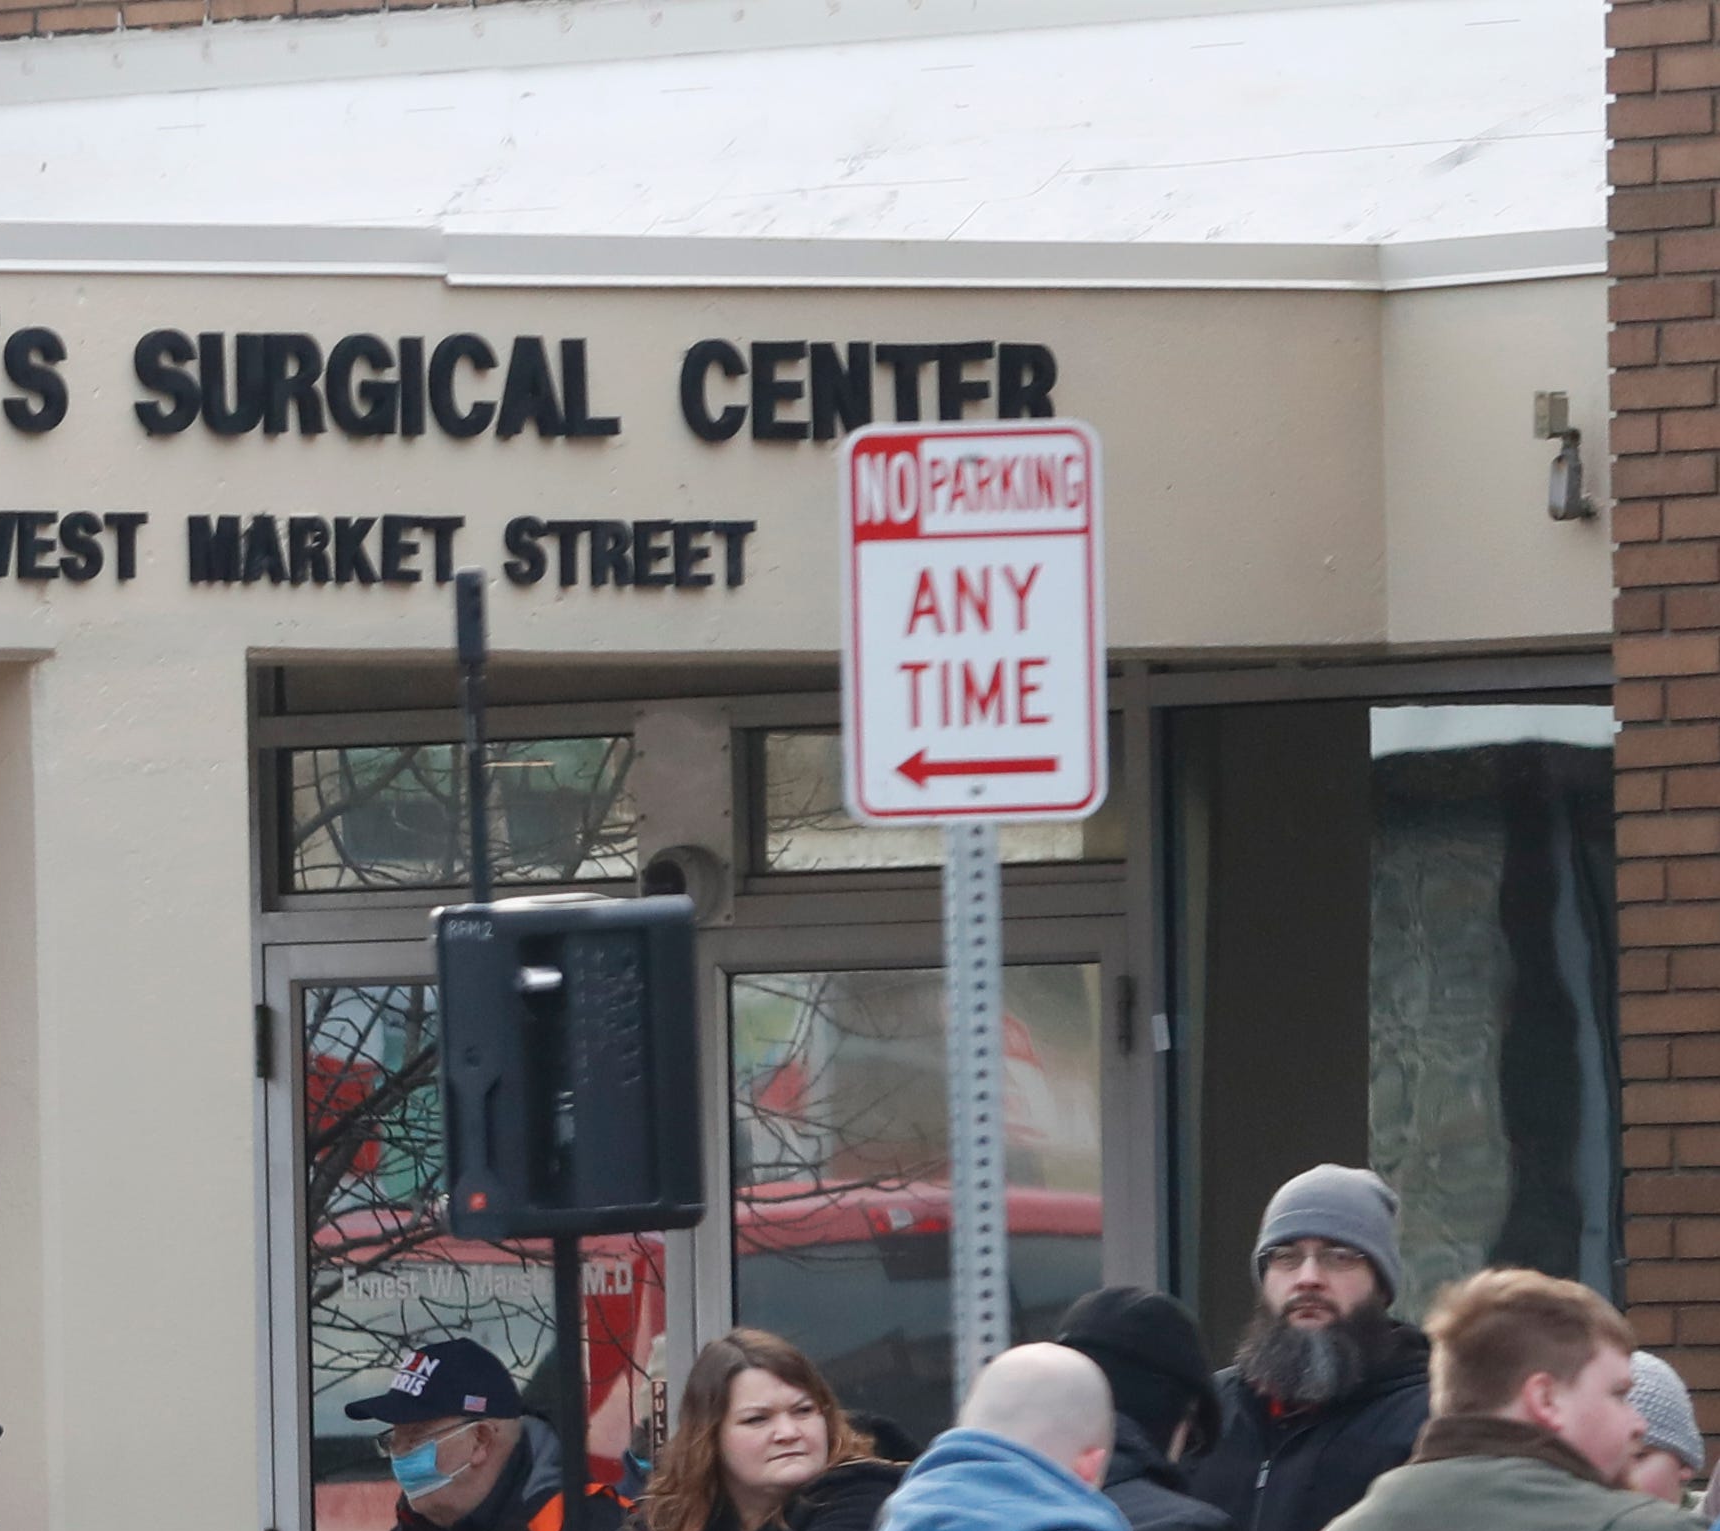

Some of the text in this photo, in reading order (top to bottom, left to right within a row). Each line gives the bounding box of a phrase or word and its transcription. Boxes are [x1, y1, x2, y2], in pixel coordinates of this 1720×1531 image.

[132, 328, 621, 439] SURGICAL
[679, 339, 1059, 444] CENTER
[856, 451, 1085, 524] NO PARKING
[188, 513, 465, 586] MARKET
[503, 516, 757, 588] STREET
[906, 563, 1041, 637] ANY
[900, 657, 1049, 729] TIME
[342, 1266, 418, 1299] Ernest
[470, 1263, 551, 1297] Marsh
